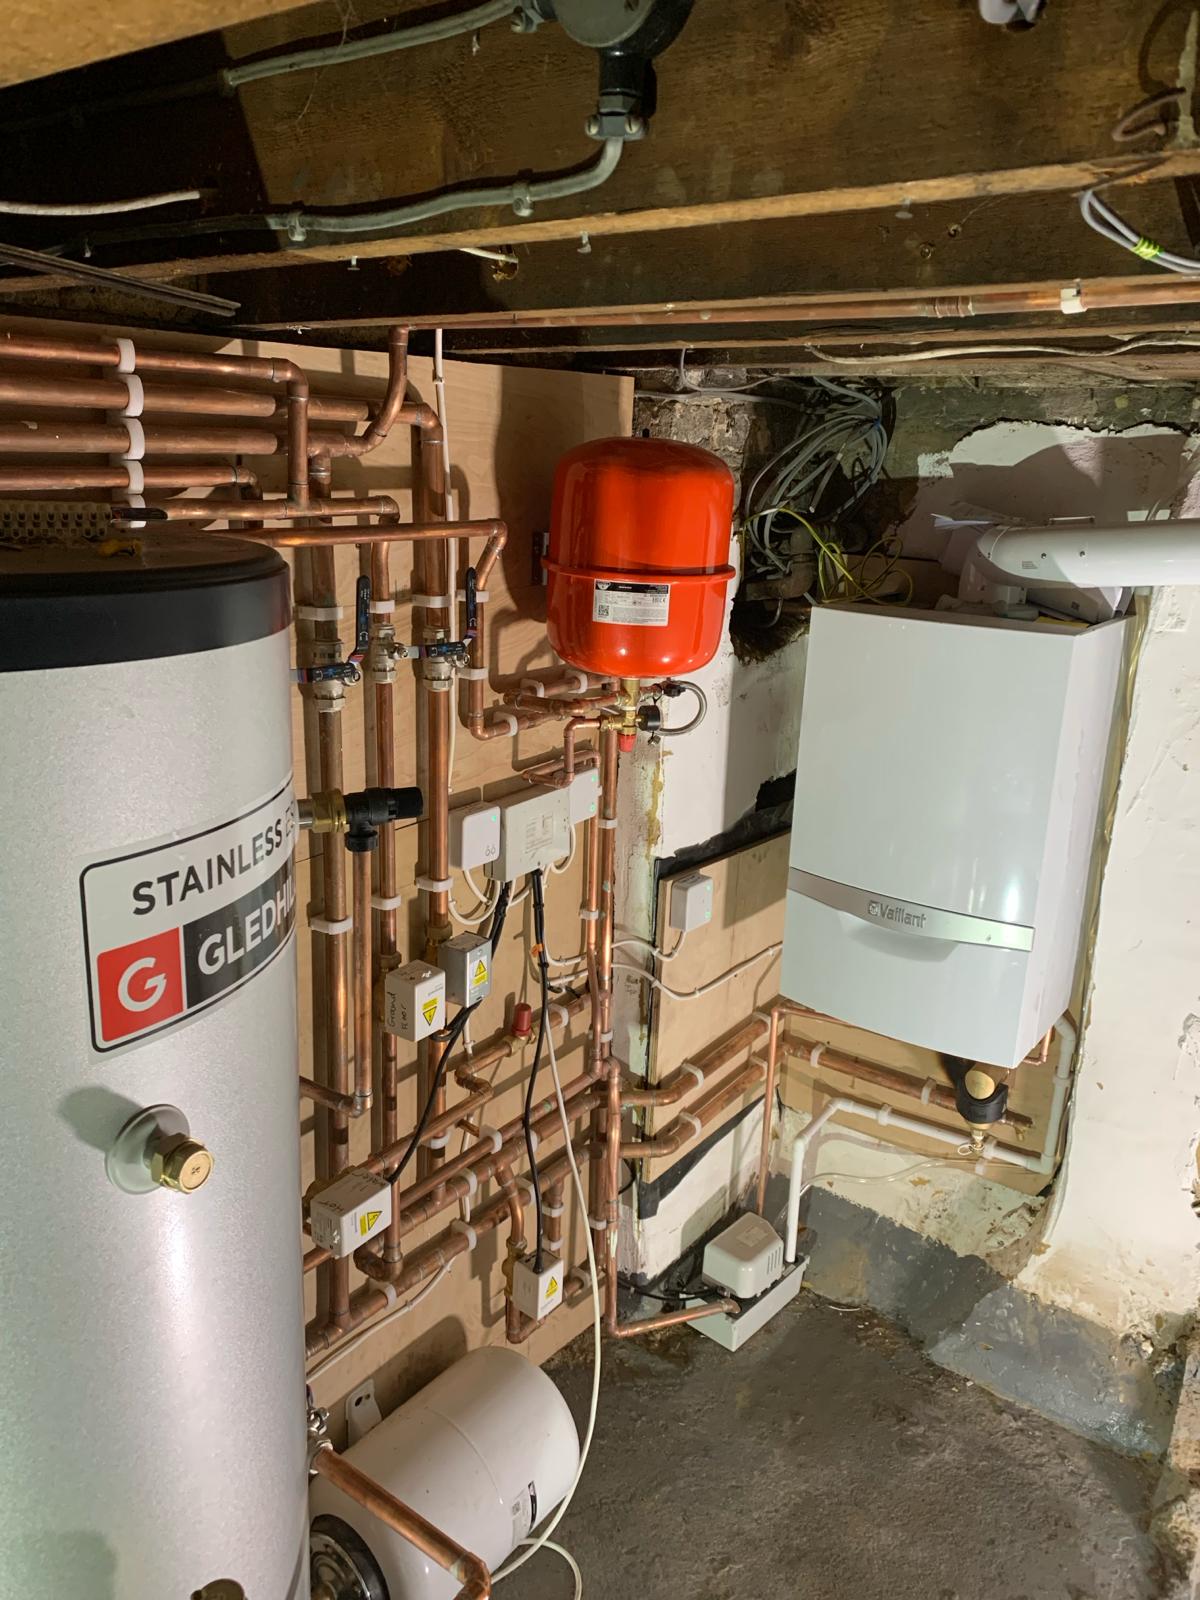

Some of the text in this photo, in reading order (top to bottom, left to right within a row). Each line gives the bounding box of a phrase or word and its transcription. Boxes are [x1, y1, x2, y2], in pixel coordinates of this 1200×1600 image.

[132, 818, 283, 916] STAINLESS
[880, 903, 927, 929] Vaillant
[117, 956, 168, 1013] G
